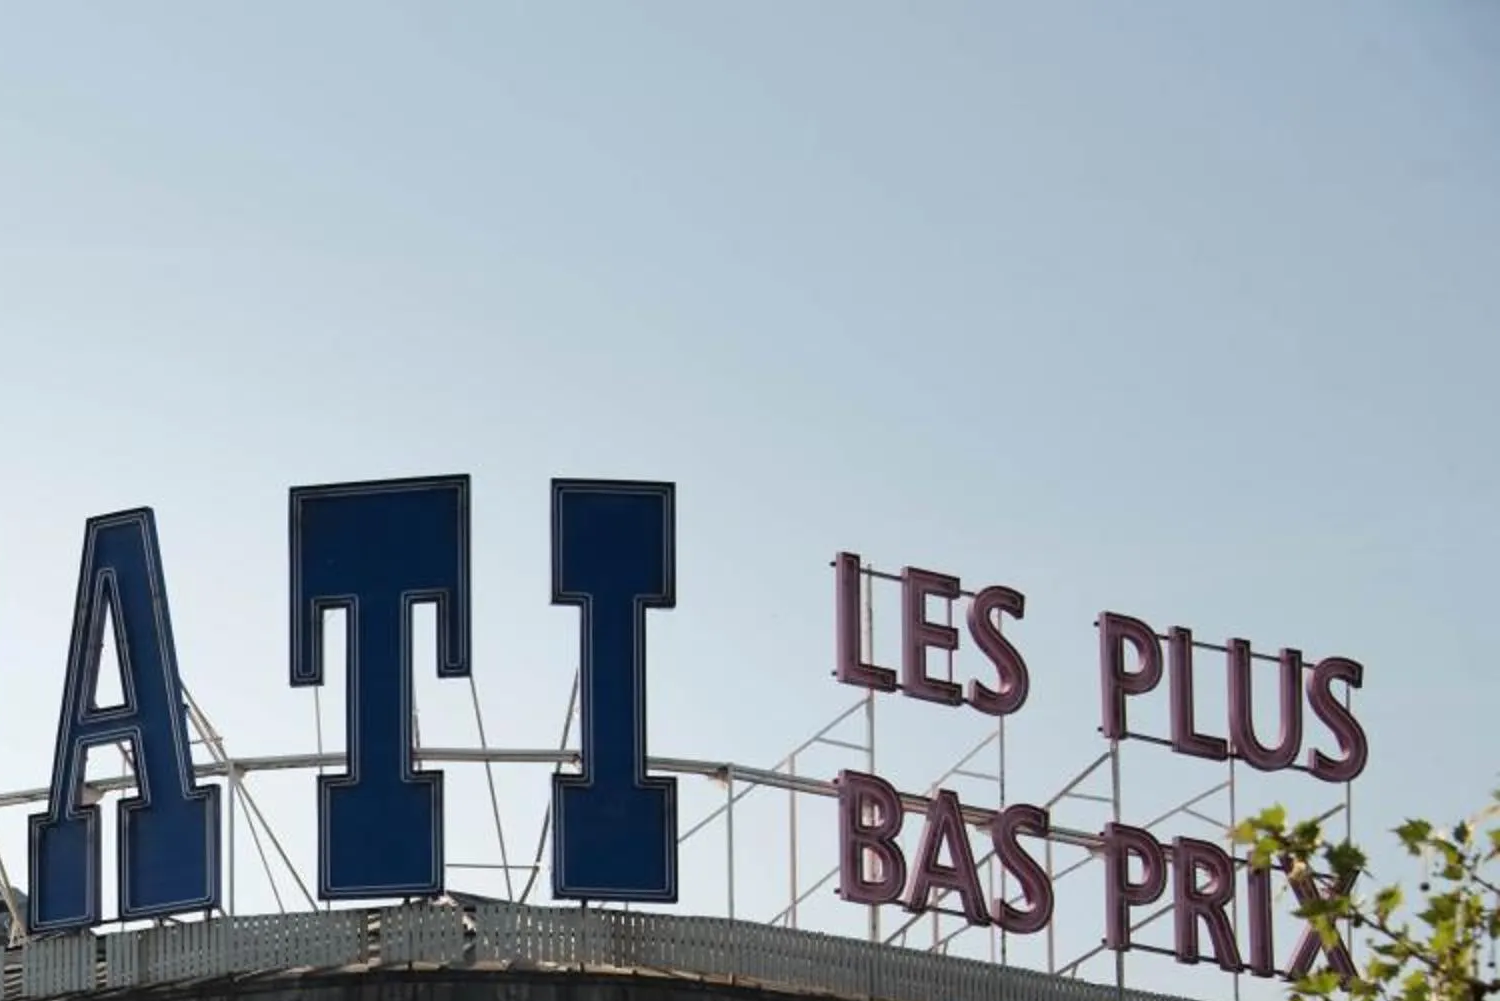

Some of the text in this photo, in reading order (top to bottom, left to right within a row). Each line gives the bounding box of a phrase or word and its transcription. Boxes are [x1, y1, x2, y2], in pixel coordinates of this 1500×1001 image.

[835, 551, 1369, 783] LES PLUS
[838, 769, 1362, 990] BAS PRIX
